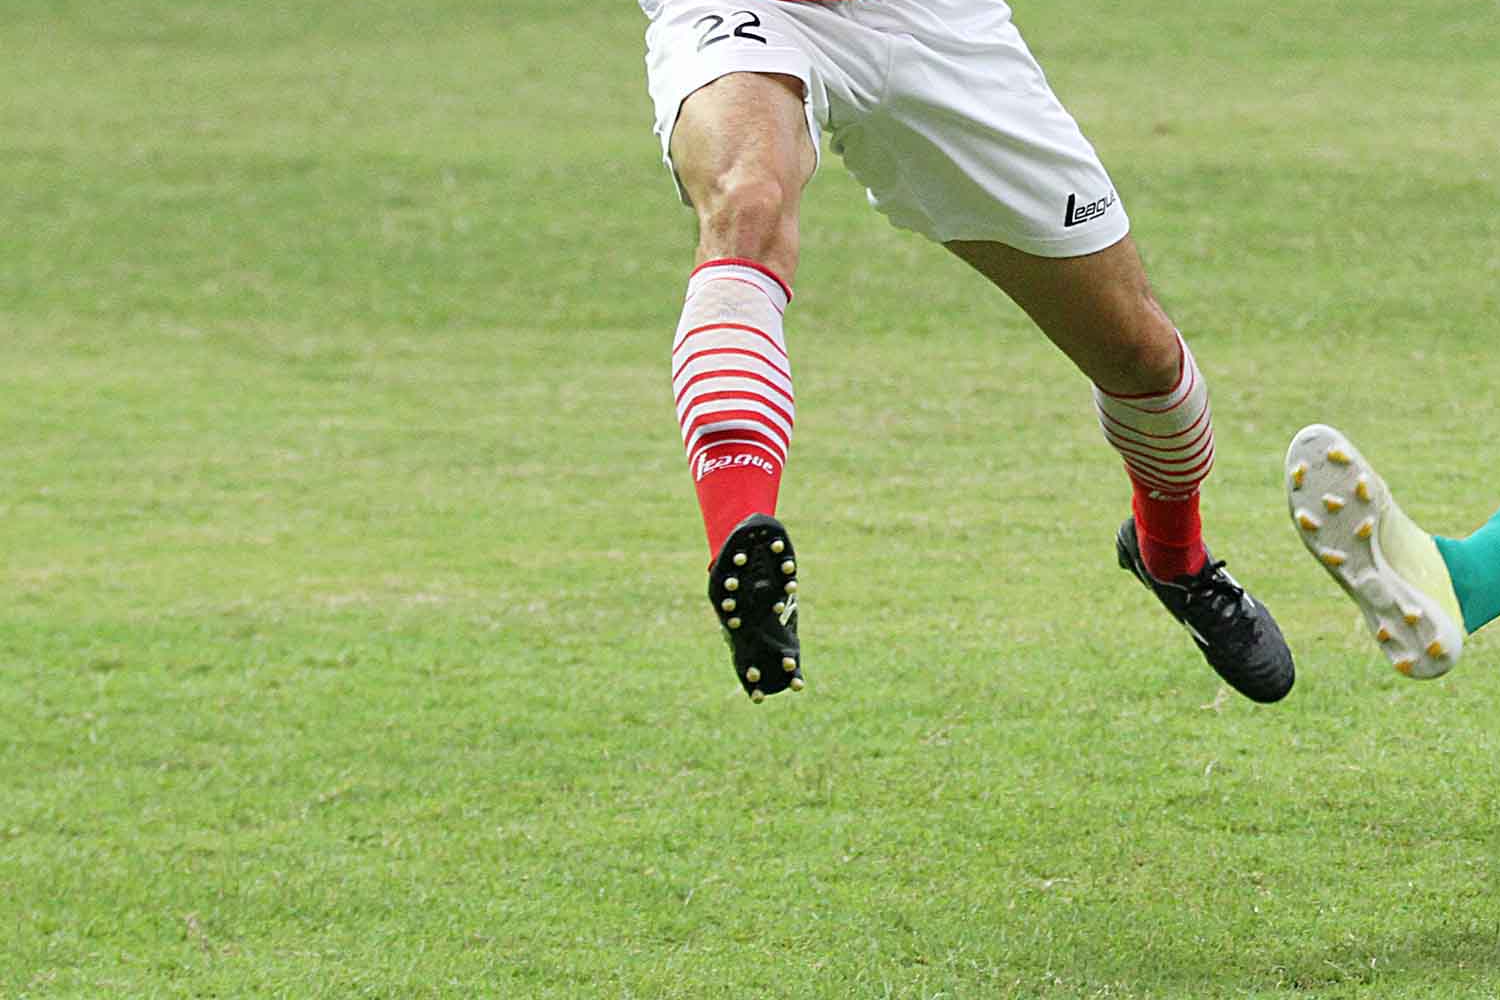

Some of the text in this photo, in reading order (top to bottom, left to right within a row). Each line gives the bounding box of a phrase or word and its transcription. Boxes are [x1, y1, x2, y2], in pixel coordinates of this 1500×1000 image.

[693, 9, 768, 53] 22
[1063, 189, 1117, 228] Leagu
[695, 452, 776, 483] League
